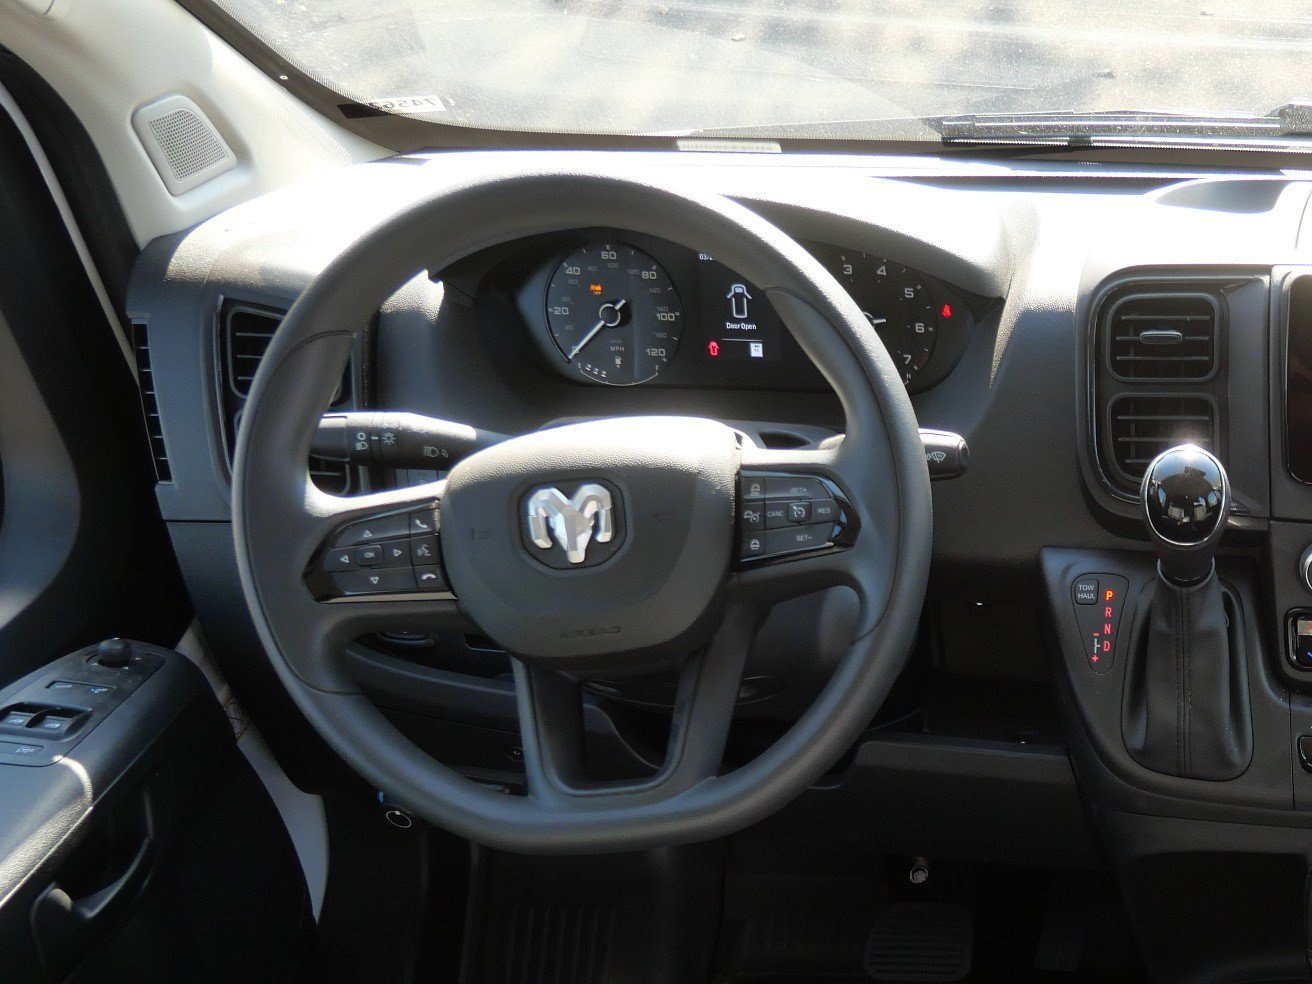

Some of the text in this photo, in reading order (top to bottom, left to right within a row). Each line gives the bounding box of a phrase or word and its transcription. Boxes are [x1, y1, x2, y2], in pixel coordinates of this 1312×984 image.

[601, 251, 617, 260] 60
[566, 266, 580, 275] 40
[842, 264, 853, 275] 3
[876, 266, 887, 276] 4
[641, 271, 657, 280] 80
[904, 288, 914, 298] 5
[554, 306, 570, 315] 20
[656, 312, 676, 321] 100
[741, 322, 757, 330] Open
[915, 322, 925, 334] 6
[646, 348, 666, 357] 120
[902, 354, 912, 364] 7
[1078, 592, 1096, 600] HAUL
[1105, 590, 1114, 600] P
[1105, 607, 1112, 618] R
[1104, 623, 1112, 635] N
[1103, 640, 1111, 652] D
